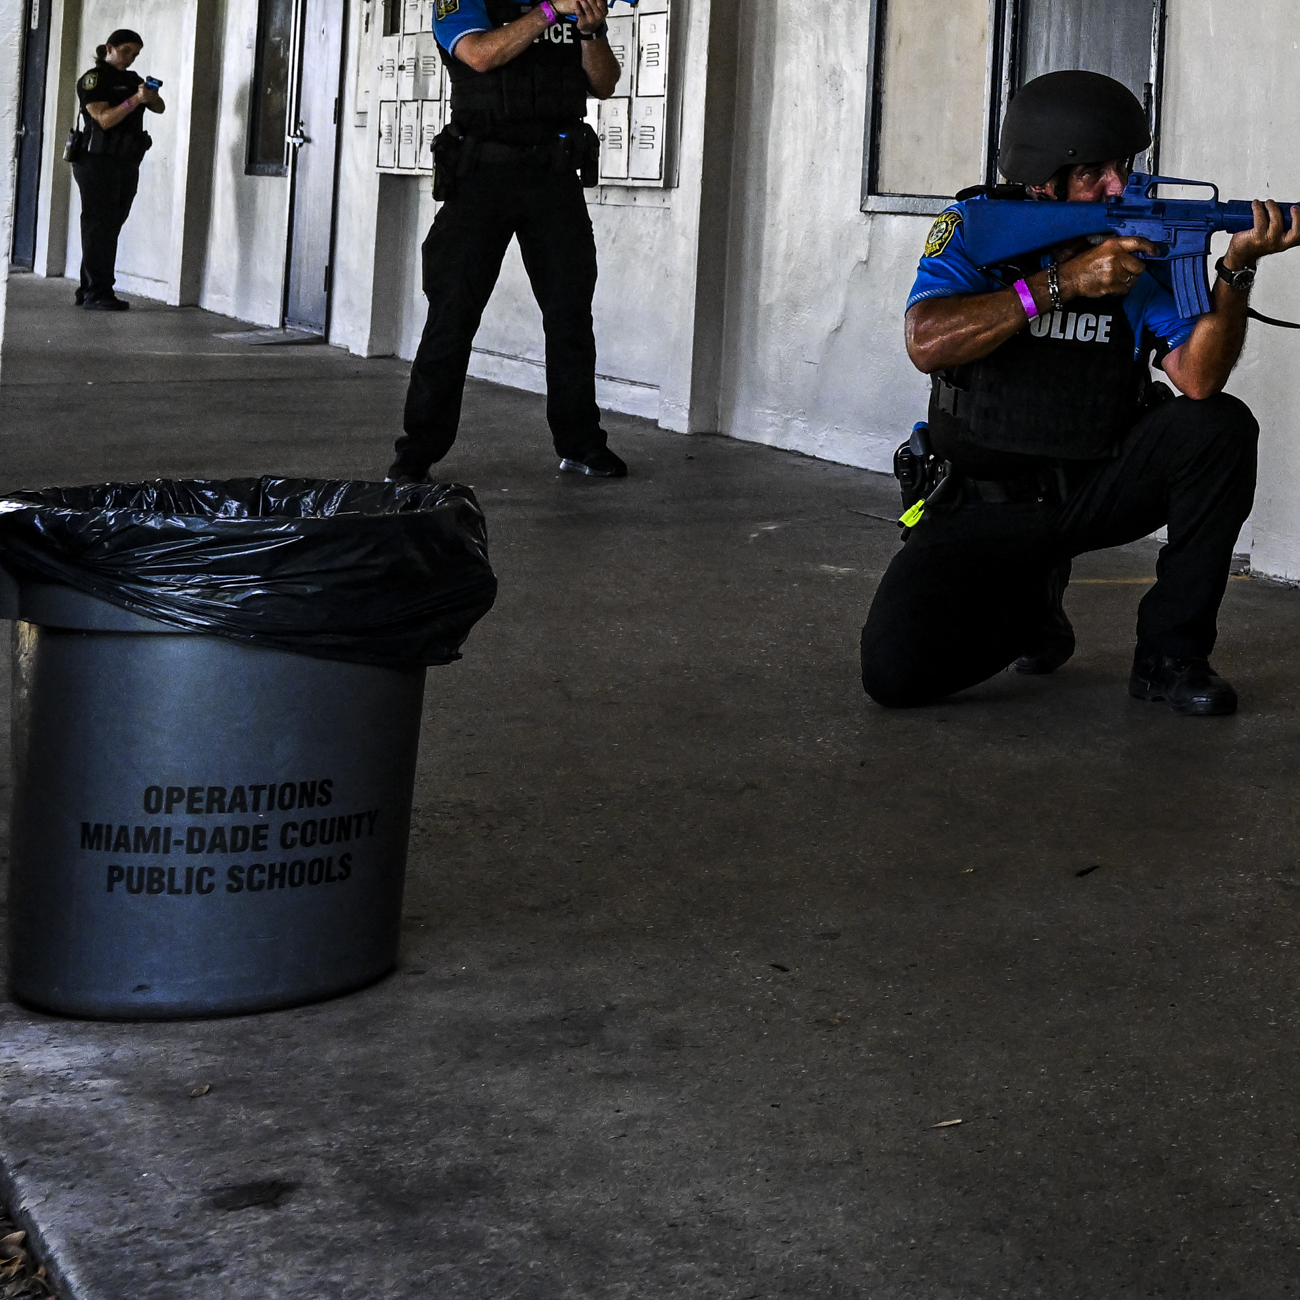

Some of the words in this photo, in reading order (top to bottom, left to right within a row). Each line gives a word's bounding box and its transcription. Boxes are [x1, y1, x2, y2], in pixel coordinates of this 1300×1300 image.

[1030, 311, 1113, 343] OLICE
[143, 779, 334, 815] OPERATIONS
[80, 821, 270, 855] MIAMI-DADE
[279, 809, 380, 850] COUNTY
[106, 865, 215, 895] PUBLIC
[226, 852, 353, 893] SCHOOLS
